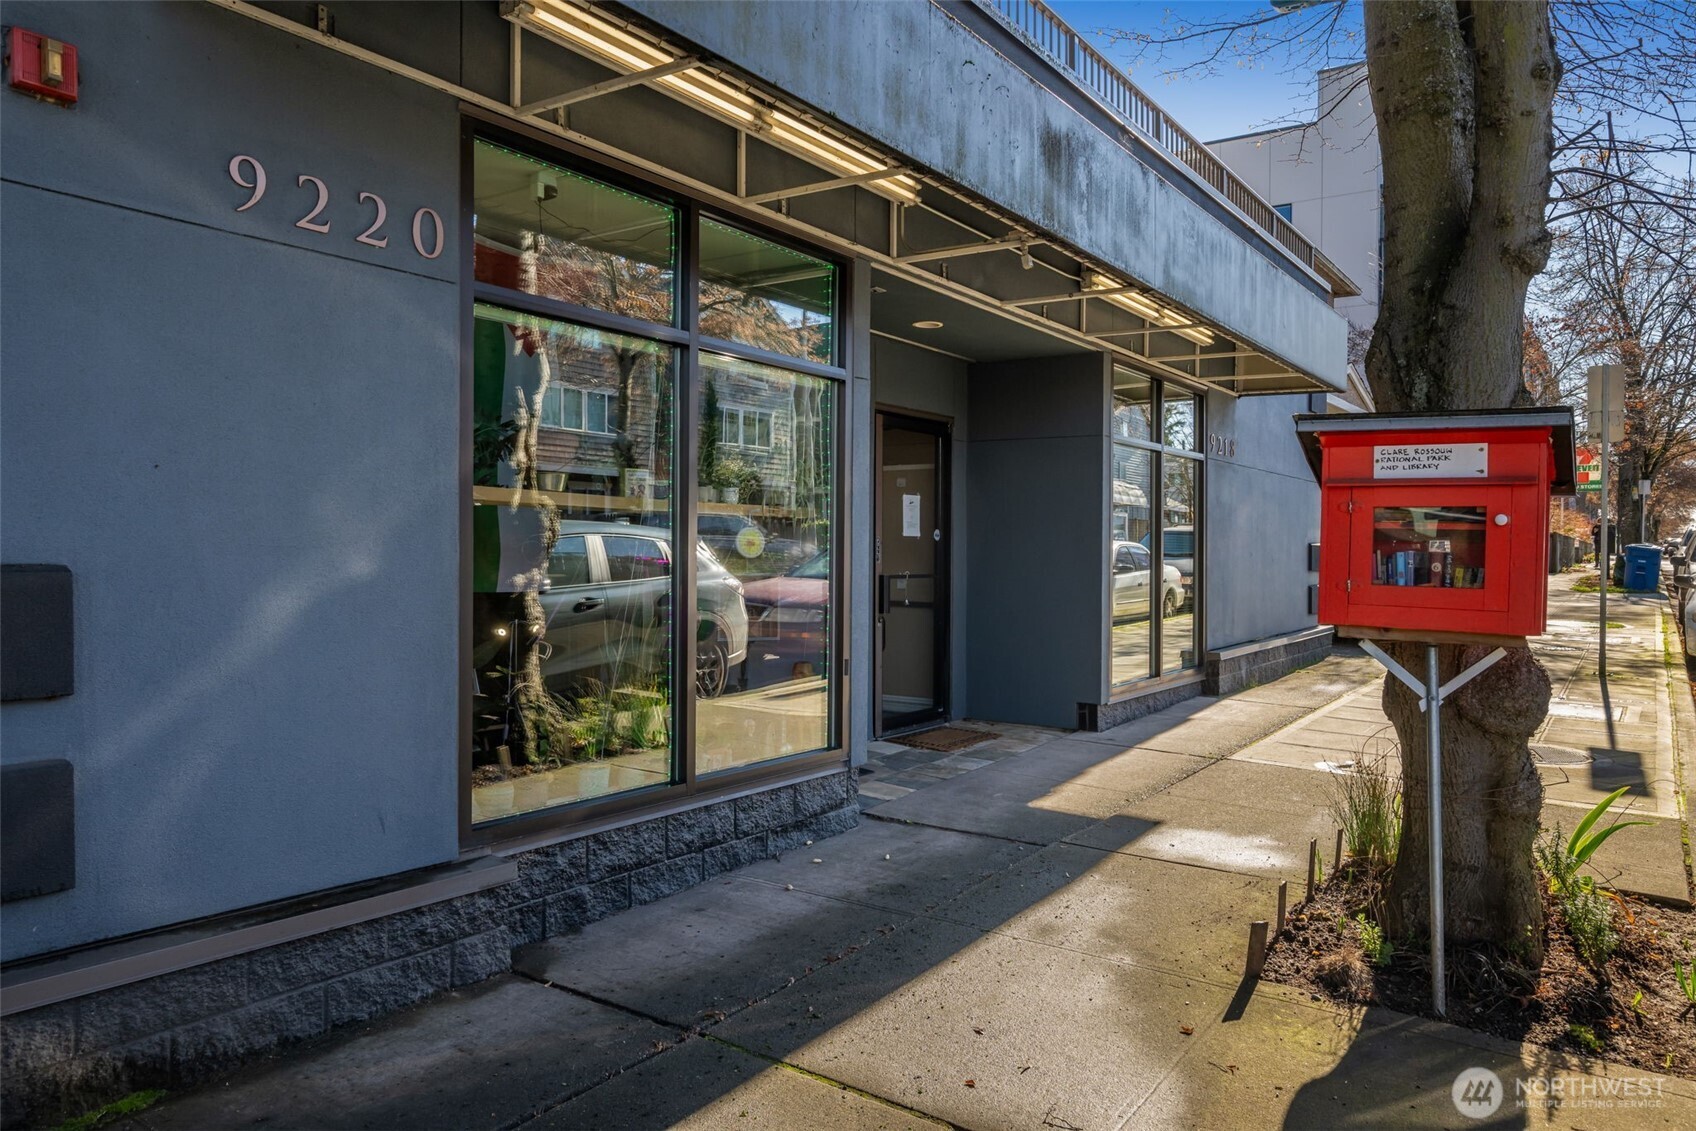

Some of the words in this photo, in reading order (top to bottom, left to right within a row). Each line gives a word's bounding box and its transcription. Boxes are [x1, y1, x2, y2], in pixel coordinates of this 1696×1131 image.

[229, 154, 444, 259] 9220
[1210, 433, 1235, 457] 9218
[1380, 448, 1409, 456] CLARE
[1414, 446, 1453, 455] ROSSOUW
[1427, 454, 1452, 462] PARK
